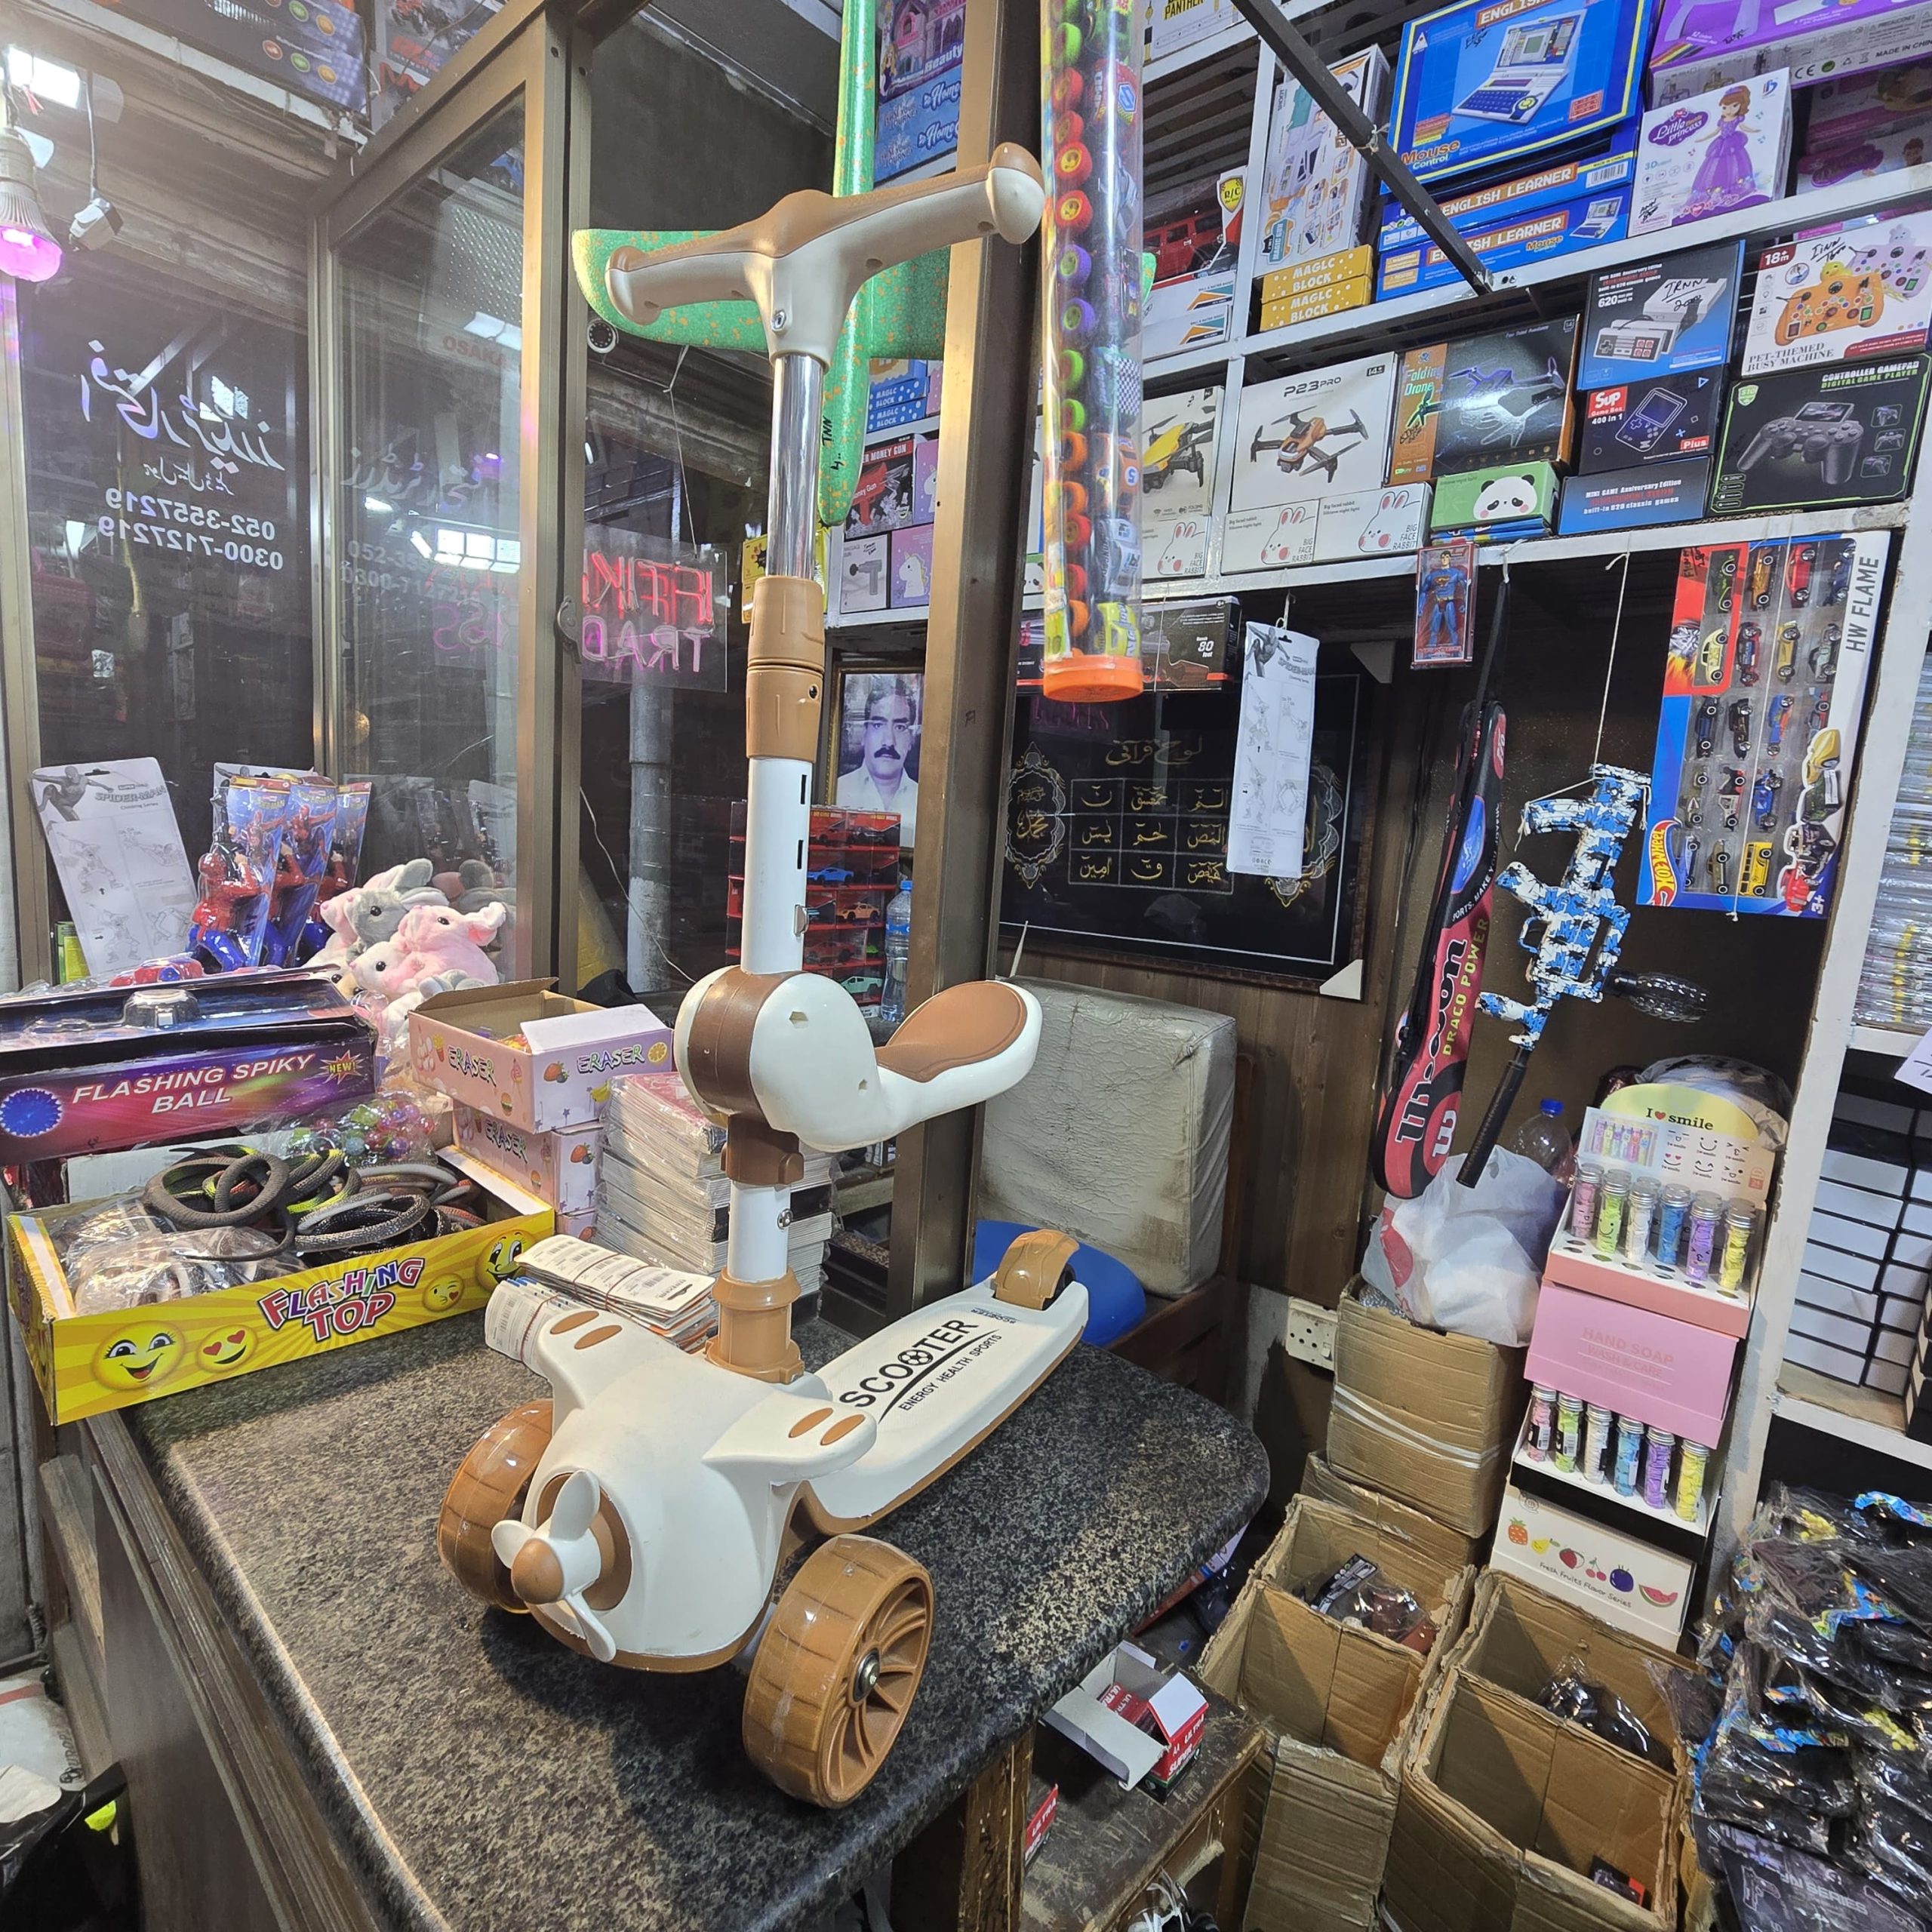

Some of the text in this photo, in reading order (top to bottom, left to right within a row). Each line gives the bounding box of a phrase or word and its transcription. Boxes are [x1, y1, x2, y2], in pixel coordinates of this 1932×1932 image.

[924, 43, 963, 70] Beauty
[1875, 47, 1900, 58] MADE
[1902, 45, 1910, 53] IN
[1653, 118, 1685, 142] Little
[1668, 120, 1703, 145] princess
[1401, 140, 1460, 165] Mouse
[1412, 153, 1450, 171] Control
[1224, 187, 1241, 199] R/C
[1441, 166, 1572, 218] ENGLISH LEARNER
[1497, 217, 1562, 248] LEARNER
[1525, 234, 1564, 252] Mouse
[1293, 257, 1335, 279] MAGLC
[1293, 272, 1332, 293] BLOCK
[1291, 289, 1333, 309] MAGLC
[1598, 294, 1619, 309] 620
[1291, 303, 1329, 323] BLOCK
[1747, 349, 1835, 372] BUSY MACHINE
[1749, 342, 1825, 364] PET-THEMED
[1820, 368, 1918, 389] DIGITAL GAME PLAYER
[1822, 360, 1920, 382] CONTROLLER GAMEPAD
[1404, 382, 1435, 396] Drone
[875, 396, 895, 408] BLOCK
[1595, 391, 1621, 409] Sup
[877, 417, 897, 428] BLOCK
[1592, 413, 1623, 426] 400 in 1
[871, 443, 906, 461] MONEY GUN
[1683, 438, 1707, 450] Plus
[866, 482, 878, 492] Gun
[1601, 487, 1620, 496] GAME
[1620, 483, 1659, 494] Anniversary
[1659, 478, 1682, 489] Edition
[1401, 533, 1417, 543] FACE
[1406, 525, 1418, 533] BIG
[1299, 546, 1313, 554] FACE
[1304, 537, 1313, 546] BIG
[1392, 540, 1417, 551] RABBIT
[1190, 558, 1203, 567] FACE
[1194, 552, 1203, 560] BIG
[1291, 553, 1313, 562] RABBIT
[1184, 566, 1203, 576] RABBIT
[1845, 555, 1880, 653] HW FLAME
[1197, 640, 1214, 652] 80
[1473, 867, 1493, 901] MAKE
[1442, 918, 1490, 1057] DRACO POWER
[328, 1060, 357, 1074] NEW!
[446, 1044, 497, 1088] ERASER
[577, 1043, 647, 1075] ERASER
[72, 1054, 316, 1104] FLASHING SPIKY
[150, 1088, 232, 1115] BALL
[1645, 1108, 1714, 1131] I smile
[485, 1118, 529, 1164] ERASER
[258, 1257, 425, 1330] FLASHING
[304, 1291, 396, 1342] TOP
[1582, 1327, 1675, 1365] HAND SOAP
[838, 1318, 980, 1408] SCOOTER
[1587, 1344, 1620, 1363] WASH
[1623, 1358, 1632, 1367] &
[1632, 1360, 1663, 1377] CARE
[898, 1333, 1003, 1412] ENERGY HEALTH SPORTS
[1540, 1561, 1632, 1608] Fresh Fruits Flavor Series
[1114, 1694, 1132, 1715] ULTR
[1183, 1713, 1204, 1745] ULTRA
[1168, 1743, 1193, 1775] SUPER
